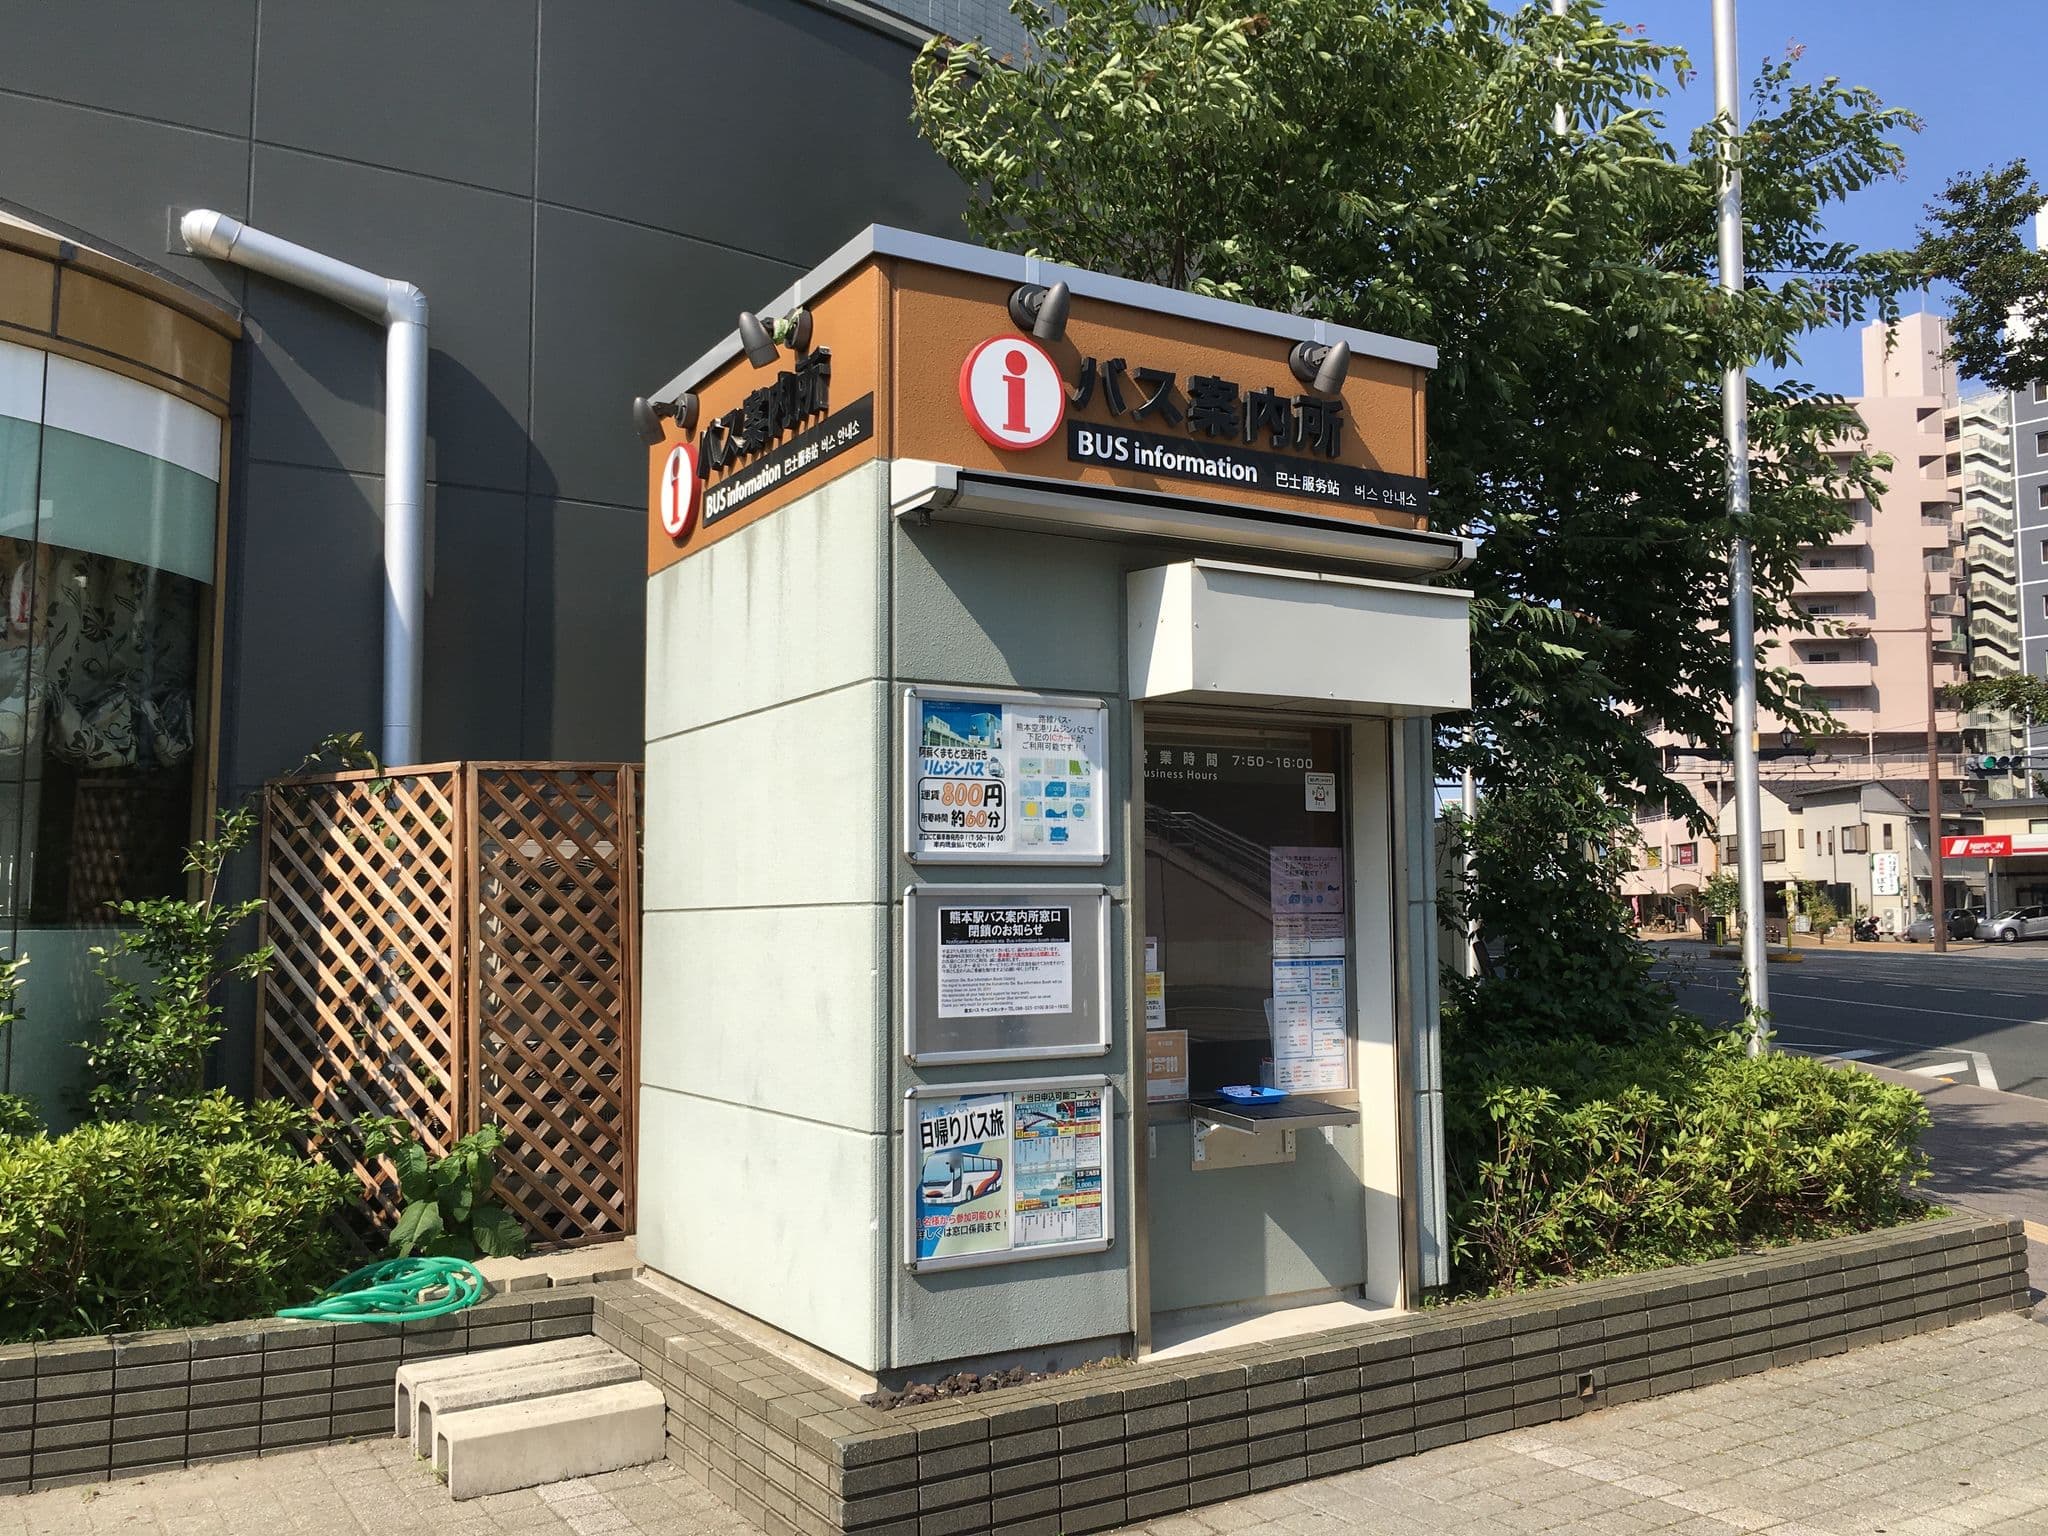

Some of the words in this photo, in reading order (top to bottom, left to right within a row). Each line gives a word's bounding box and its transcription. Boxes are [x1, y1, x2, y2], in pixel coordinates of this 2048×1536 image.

[1072, 357, 1344, 458] バス案内所
[705, 487, 727, 519] BUS
[727, 463, 782, 503] information
[821, 434, 836, 453] 버스
[837, 419, 861, 445] 안내소
[1077, 430, 1129, 461] BUS
[1134, 441, 1258, 483] information
[1275, 471, 1341, 497] 巴士服务站
[1354, 484, 1379, 502] 버스
[1382, 488, 1418, 508] 안내소
[923, 760, 985, 776] リムジンバス
[1144, 768, 1184, 779] usiness
[1186, 769, 1218, 781] Hours
[942, 782, 1003, 807] 800円
[951, 809, 1001, 828] 約60分
[949, 910, 1061, 924] 熊本駅バス案内所窓口
[968, 924, 1044, 937] 閉鎖のお知らせ
[1027, 1091, 1091, 1102] 当日申込可能コース
[920, 1108, 1005, 1150] 日帰りバス旅
